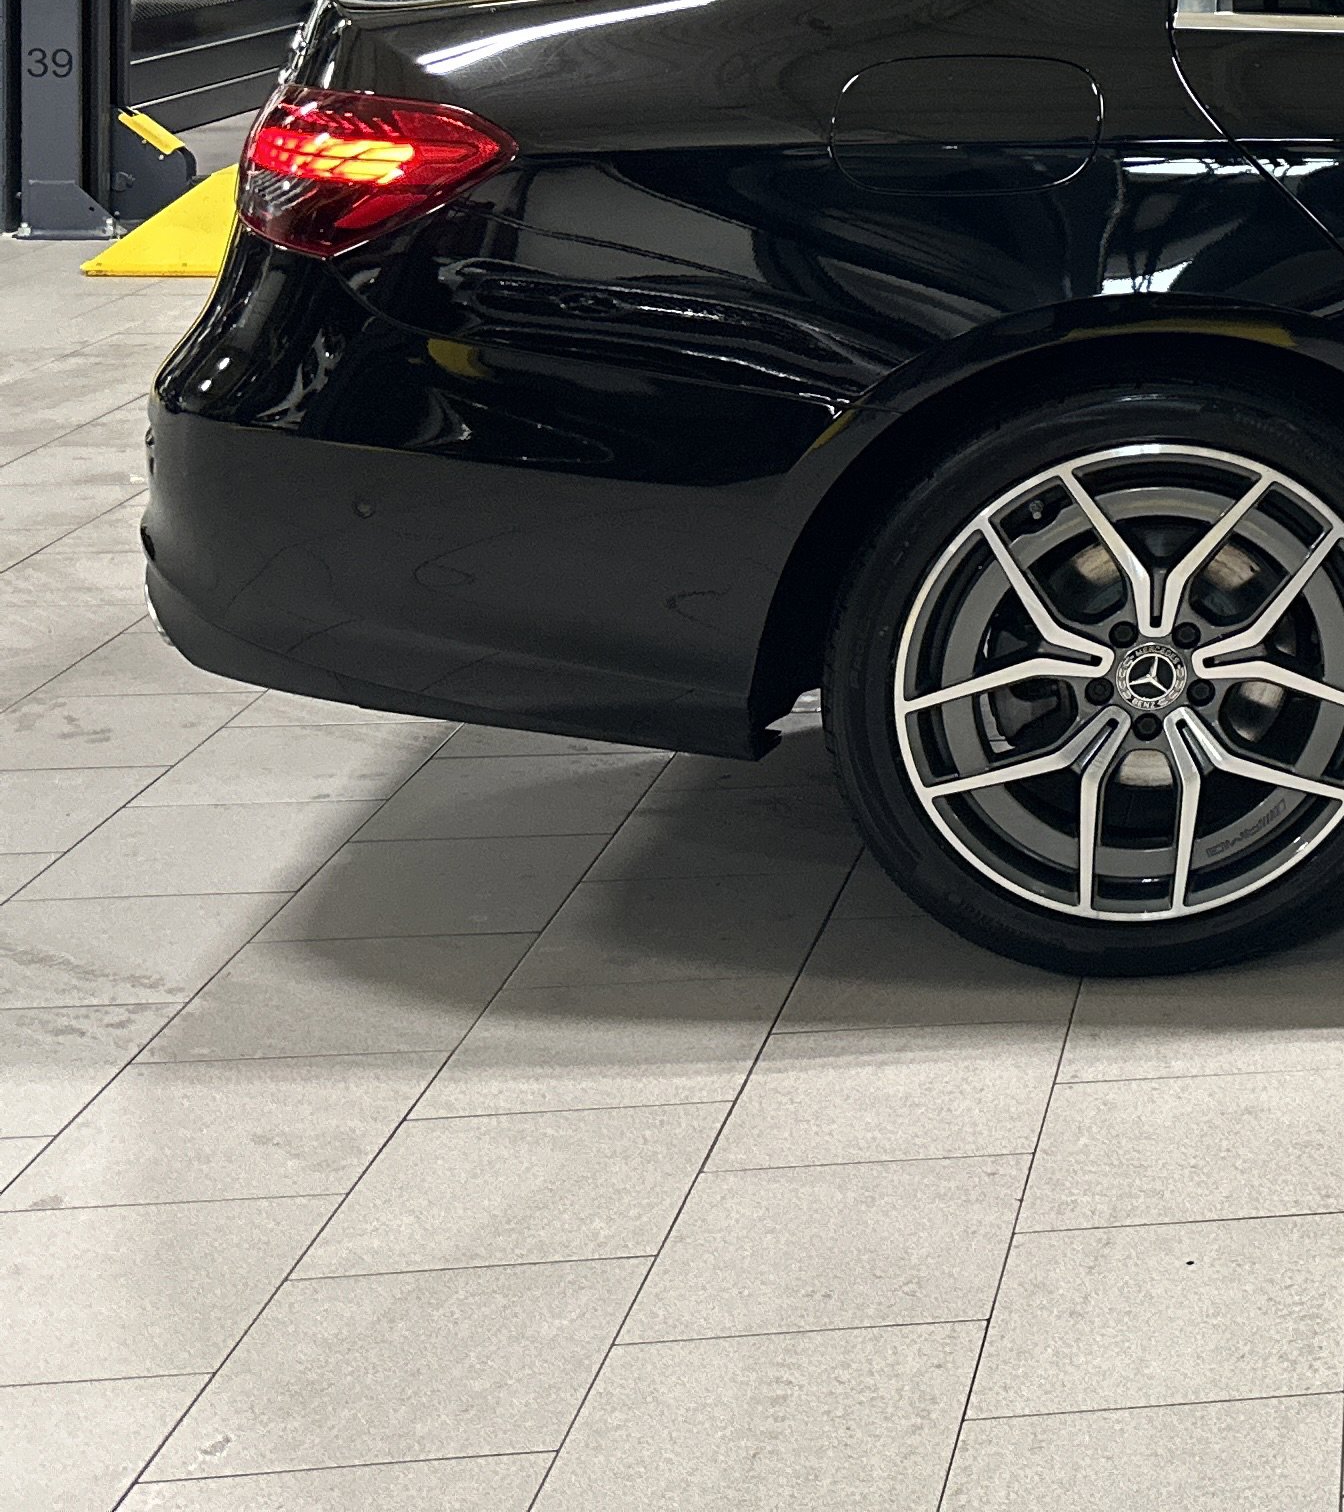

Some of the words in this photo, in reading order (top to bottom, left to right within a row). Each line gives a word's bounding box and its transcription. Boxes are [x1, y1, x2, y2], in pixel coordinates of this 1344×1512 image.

[27, 48, 73, 78] 39
[1135, 644, 1181, 665] MERCEDES
[1132, 697, 1157, 709] BENZ
